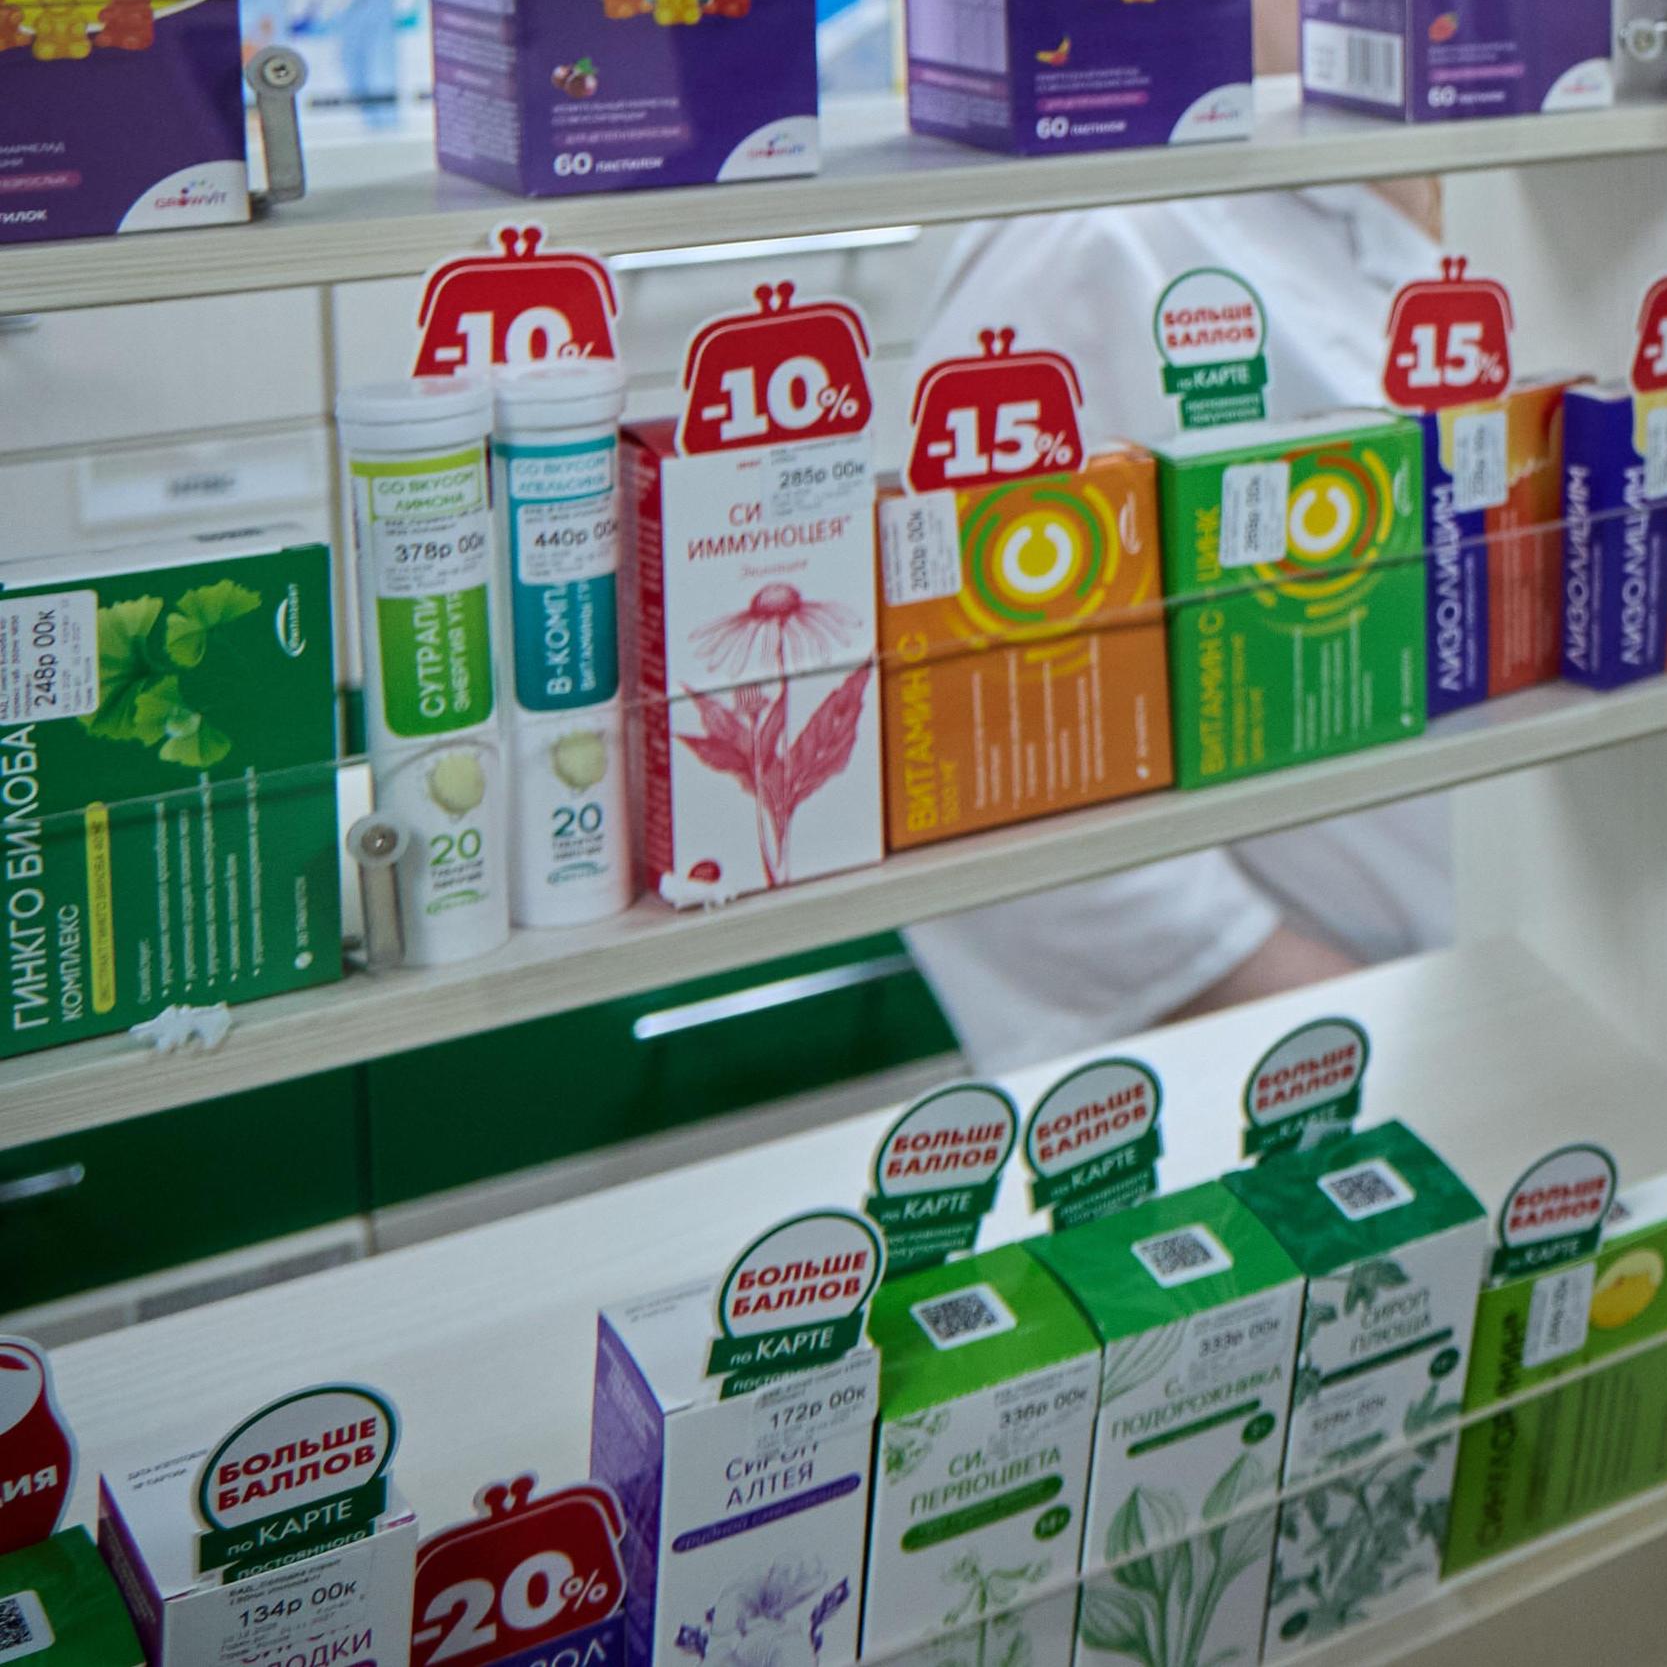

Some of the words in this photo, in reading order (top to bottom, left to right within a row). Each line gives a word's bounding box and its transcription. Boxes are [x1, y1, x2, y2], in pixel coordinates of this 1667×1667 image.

[553, 151, 593, 177] 60
[1163, 303, 1253, 327] БОЛЬШЕ
[1166, 326, 1255, 350] БАЛЛОВ
[701, 354, 860, 443] -10%
[927, 399, 1073, 479] -15%
[0, 723, 45, 883] БИЛОБА
[552, 801, 604, 838] 20
[429, 828, 482, 867] 20
[7, 885, 49, 1032] ГИНКГО
[58, 903, 83, 1023] КОМПЛЕКС
[1035, 1082, 1146, 1141] БОЛЬШЕ
[1038, 1104, 1147, 1164] БАЛЛОВ
[892, 1121, 1006, 1155] БОЛЬШЕ
[886, 1145, 999, 1180] БАЛЛОВ
[1070, 1147, 1138, 1190] КАРТЕ
[903, 1191, 973, 1220] КАРТЕ
[736, 1249, 869, 1294] БОЛЬШЕ
[732, 1276, 862, 1319] БАЛЛОВ
[754, 1325, 836, 1364] КАРТЕ
[218, 1416, 378, 1486] БОЛЬШЕ
[0, 1464, 58, 1509] ИЯ
[217, 1443, 377, 1512] БАЛЛОВ
[725, 1461, 815, 1511] АЛТЕЯ
[226, 1539, 255, 1558] по
[258, 1496, 354, 1548] КАРТЕ
[238, 1598, 303, 1628] 134р
[311, 1578, 358, 1605] 00к
[411, 1549, 609, 1666] -20%
